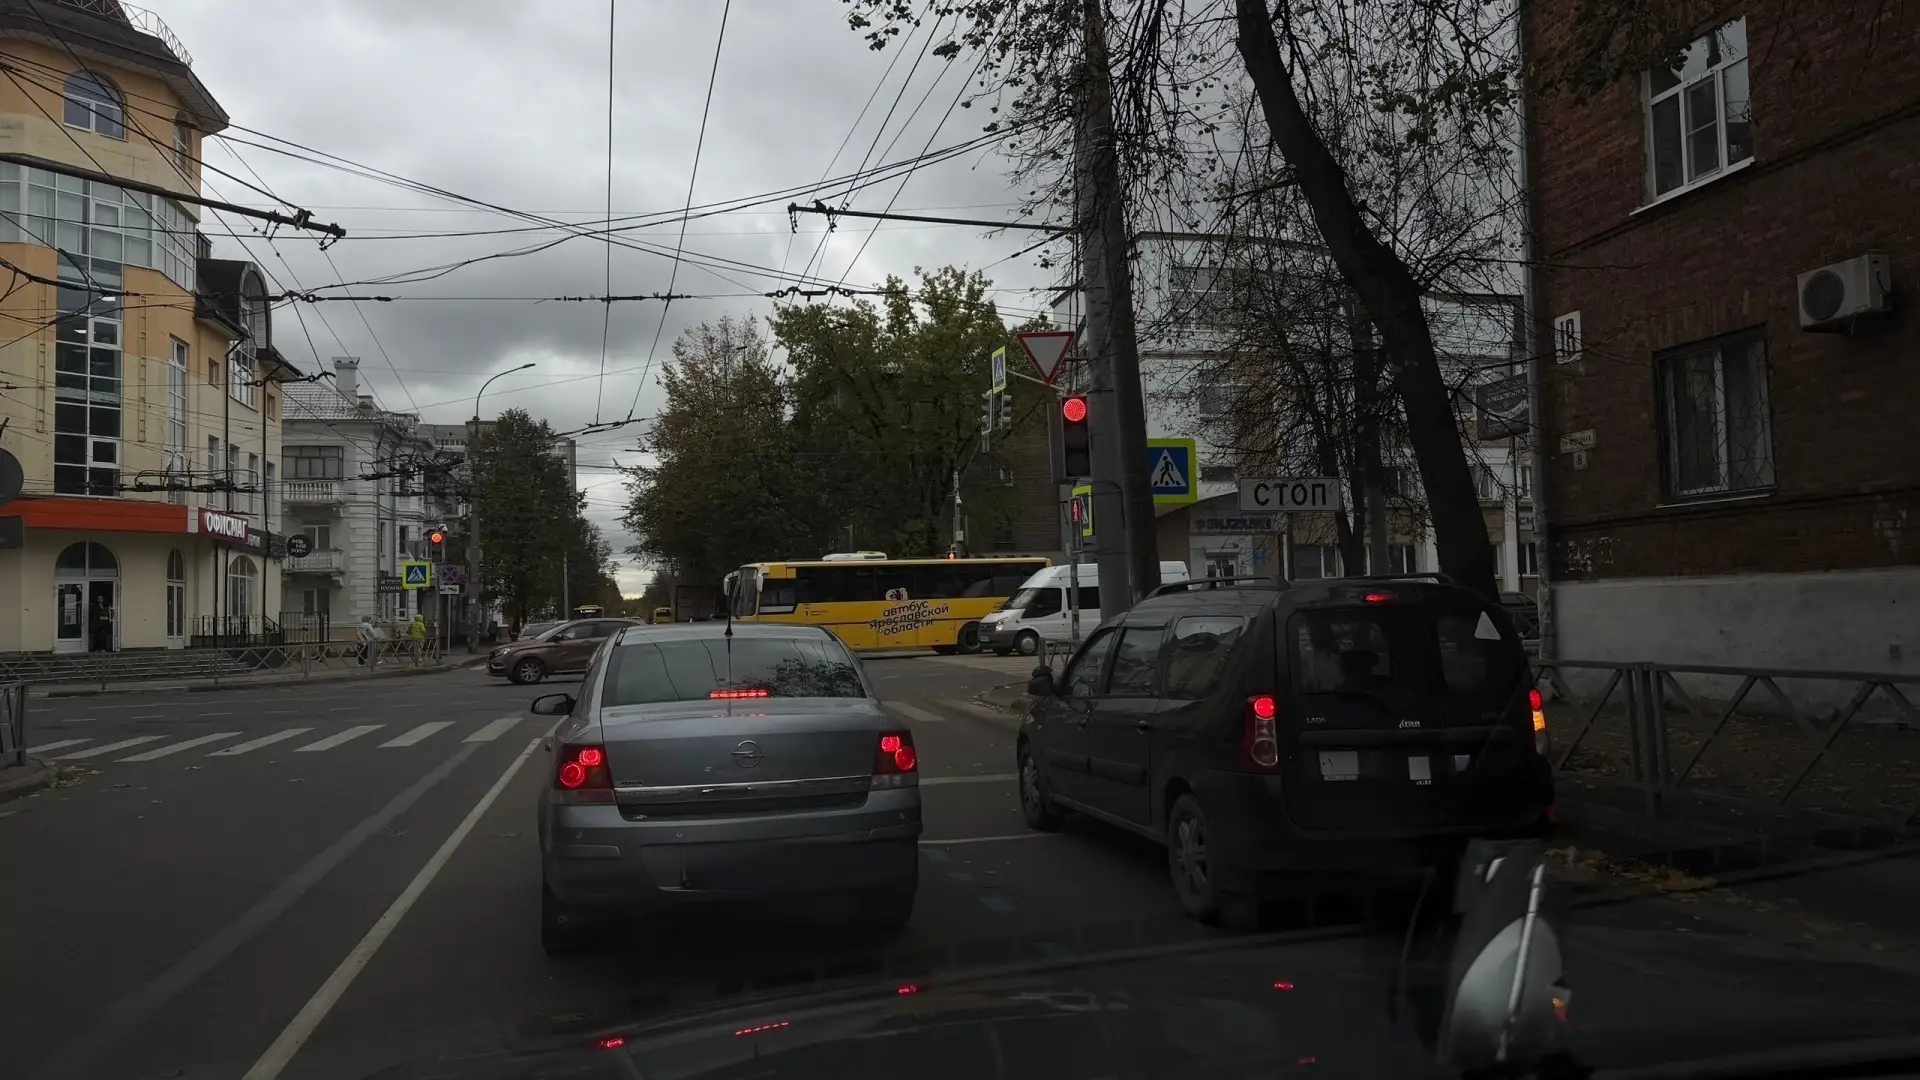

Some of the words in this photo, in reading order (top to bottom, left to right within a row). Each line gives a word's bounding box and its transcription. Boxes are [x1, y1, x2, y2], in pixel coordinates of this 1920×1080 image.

[1254, 483, 1327, 506] СТОП
[206, 512, 247, 539] ОФИСМАГ
[1206, 518, 1272, 530] SUZUKI
[868, 604, 949, 630] Ярославской
[883, 600, 929, 617] автобус
[883, 619, 933, 636] области
